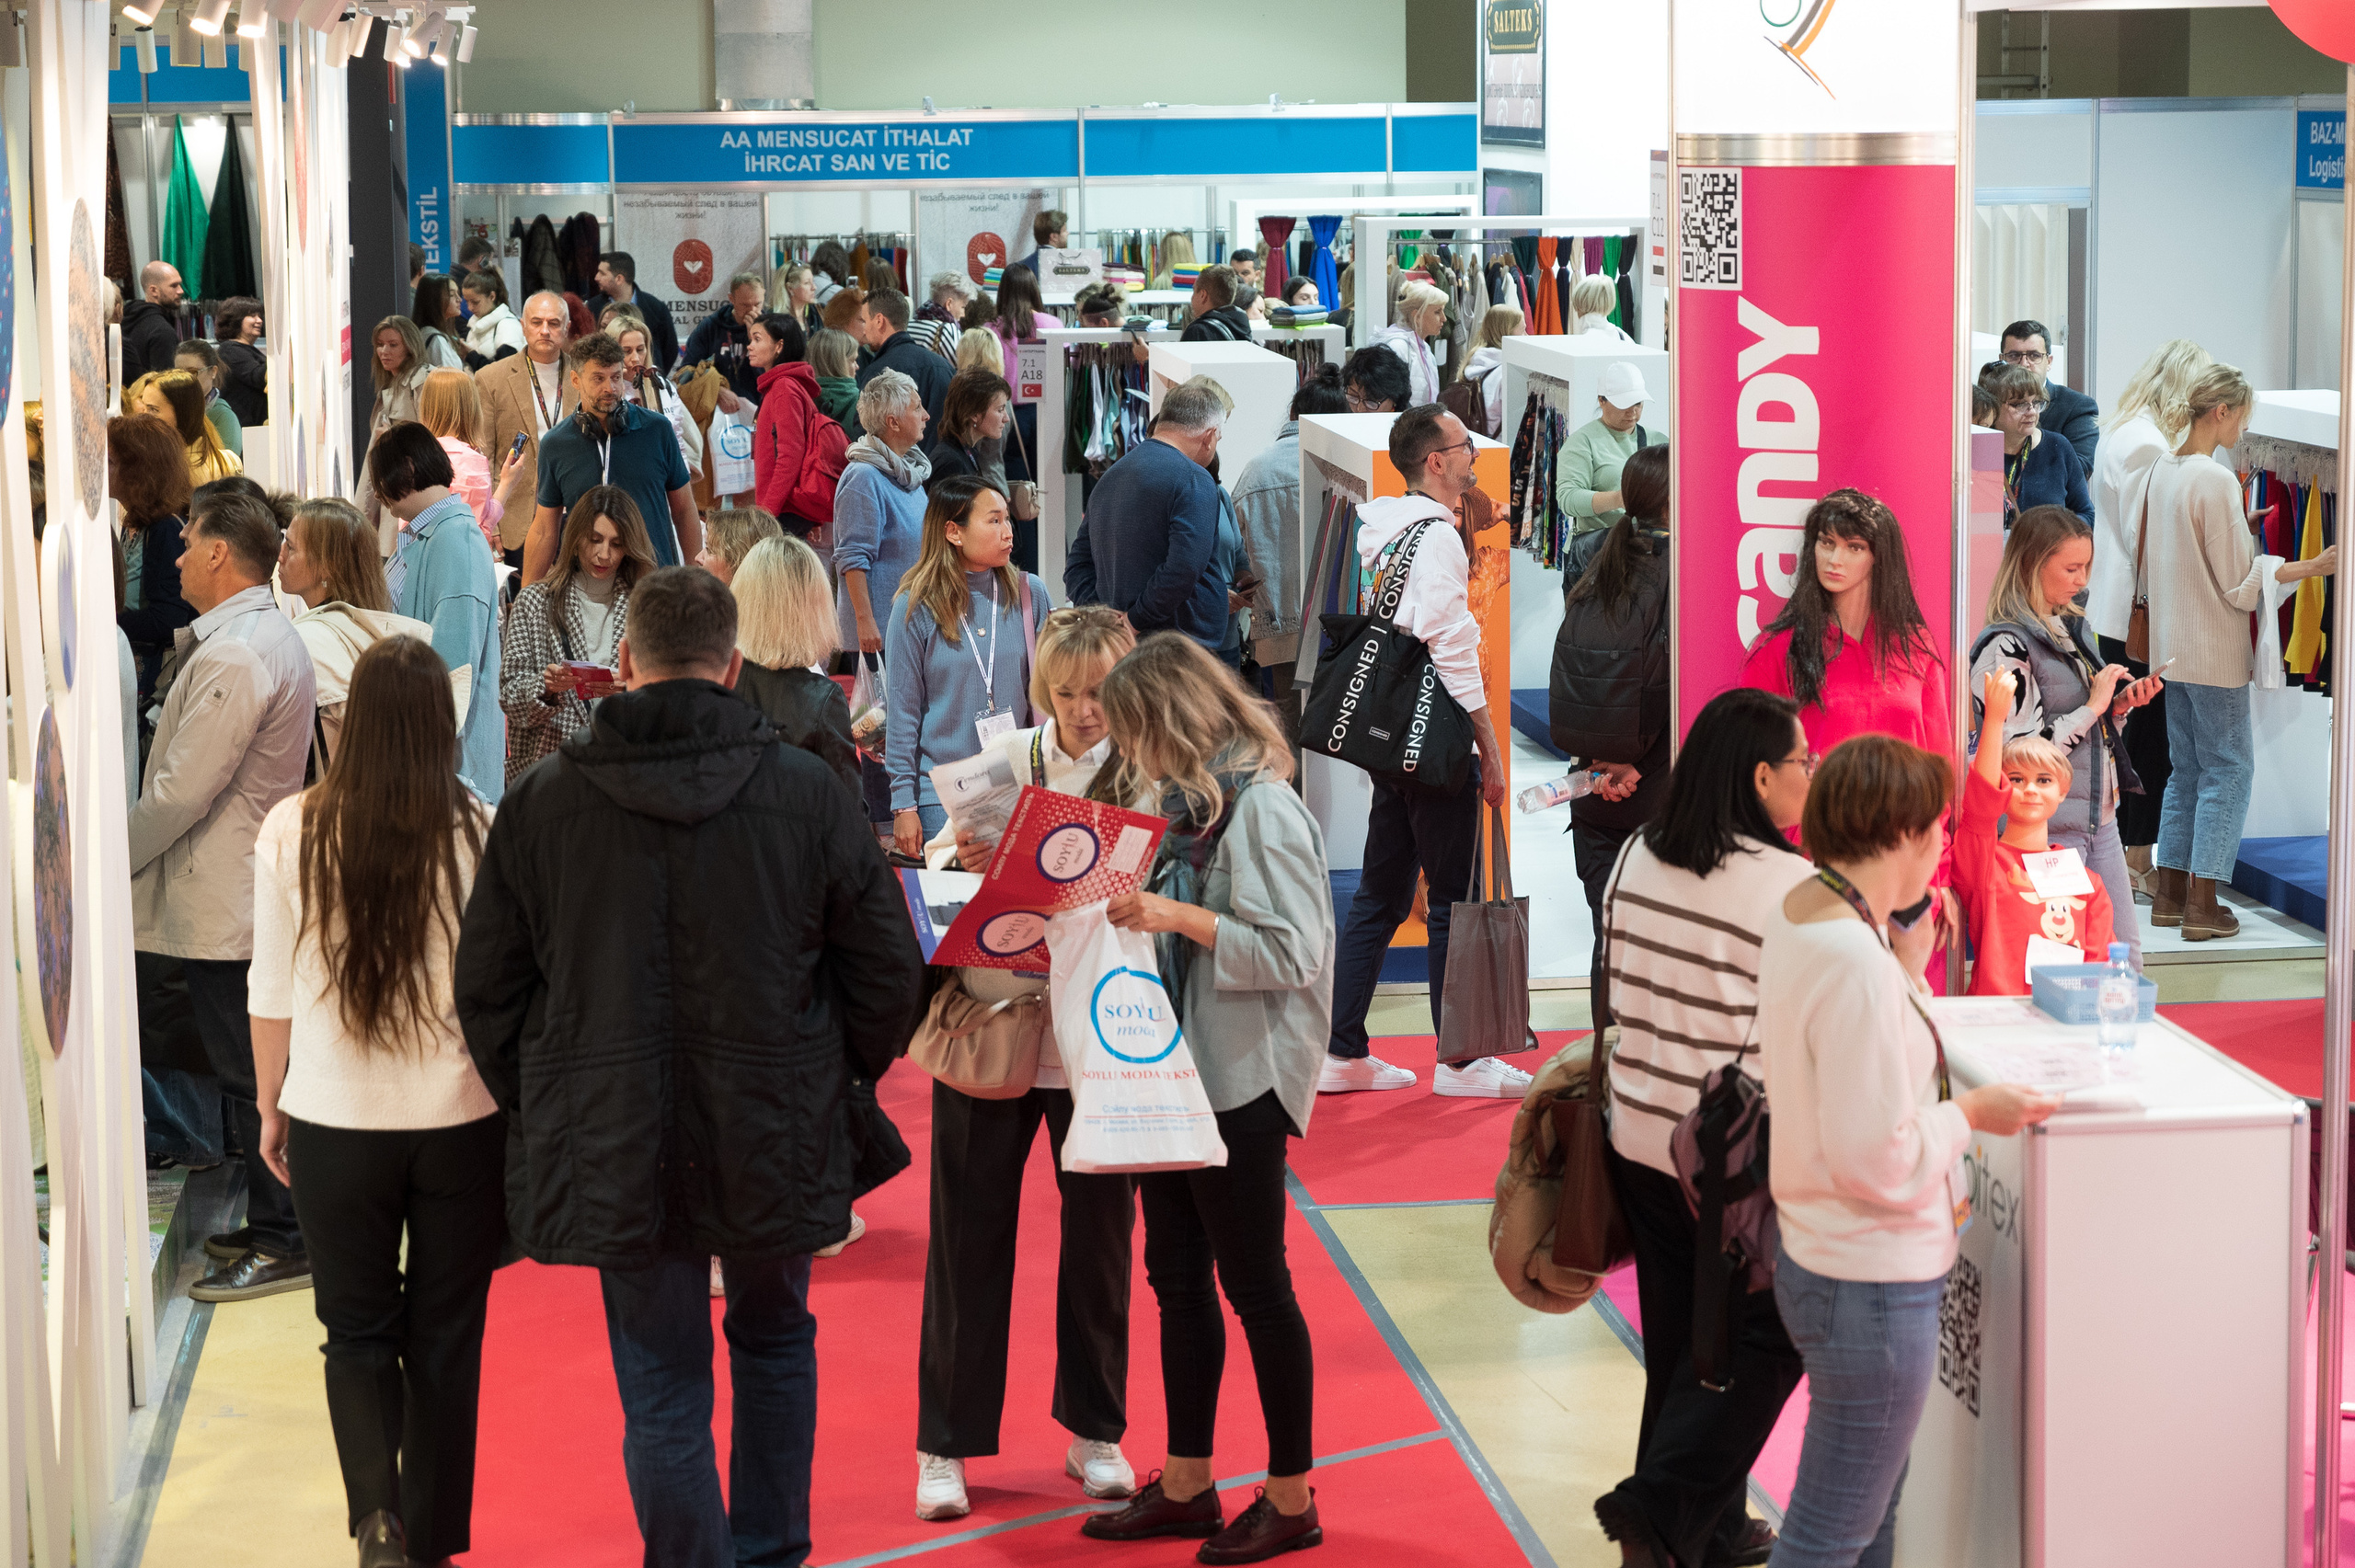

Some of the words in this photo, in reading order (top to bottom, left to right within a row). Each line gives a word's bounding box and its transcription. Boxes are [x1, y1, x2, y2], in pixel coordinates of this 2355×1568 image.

[1494, 8, 1533, 33] SALTEKS
[720, 131, 752, 148] AA
[757, 130, 877, 148] MENSUCAT
[883, 125, 973, 146] İTHALAT
[2310, 121, 2347, 144] BAZ-M
[744, 151, 824, 173] İHRCAT
[831, 154, 875, 171] SAN
[881, 154, 910, 171] VE
[916, 149, 950, 170] TİC
[2309, 155, 2346, 184] Logisti
[1020, 370, 1043, 381] A18
[1021, 359, 1036, 368] 7.1
[1327, 638, 1380, 753] CONSIGNED
[1402, 662, 1437, 773] CONSIGNED
[1002, 832, 1018, 855] МОДА
[1012, 792, 1036, 832] ТЕКСТИЛЬ
[1082, 1070, 1117, 1081] SOYLU
[1120, 1070, 1160, 1080] MODA
[1163, 1069, 1199, 1080] TEKST
